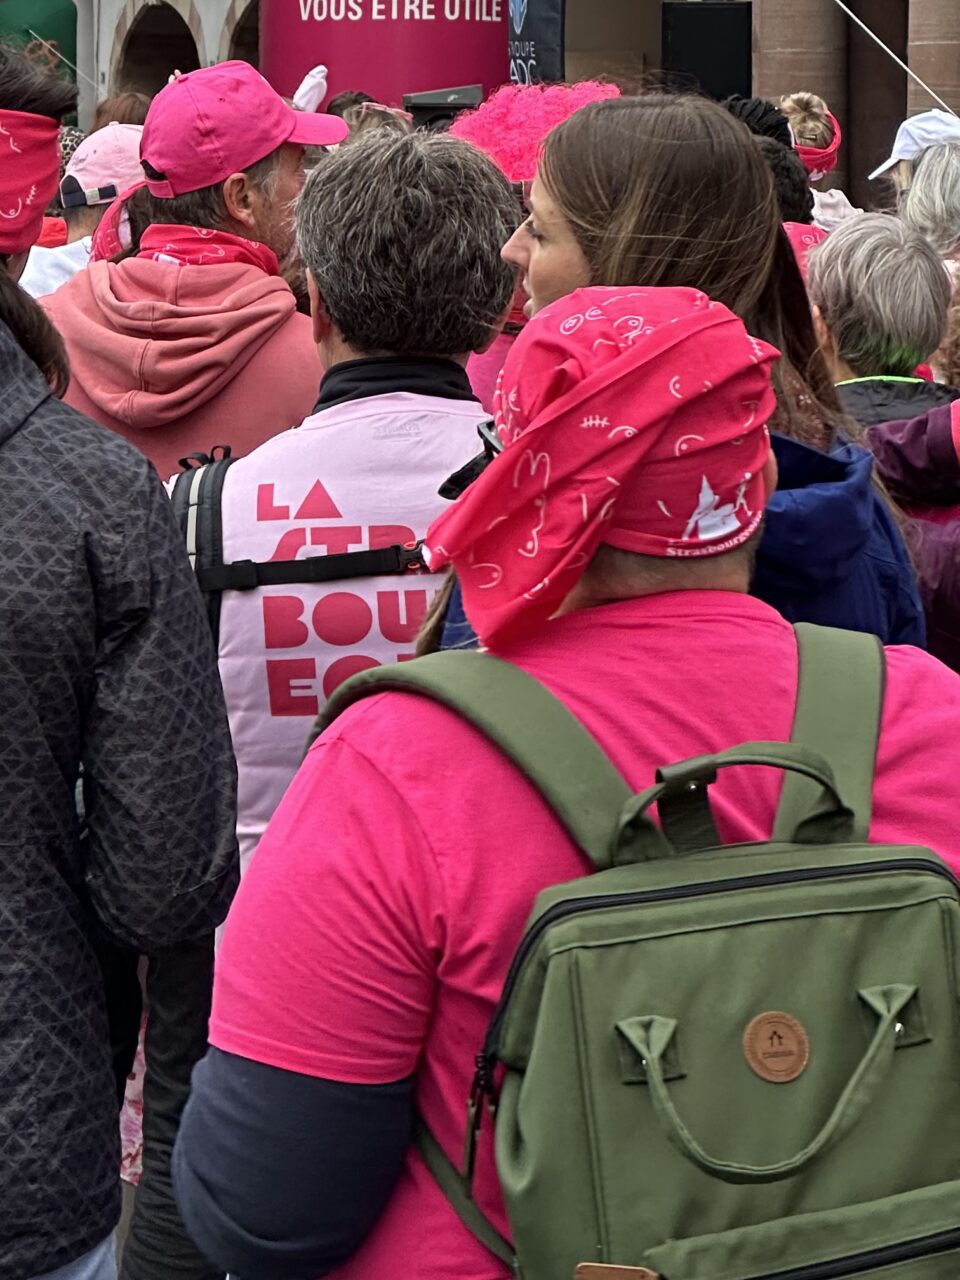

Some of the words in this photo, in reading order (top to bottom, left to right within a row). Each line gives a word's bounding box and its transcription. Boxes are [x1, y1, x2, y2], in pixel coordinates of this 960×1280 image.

[508, 41, 536, 57] ROUPE
[257, 478, 343, 522] LA
[263, 589, 441, 649] BOU
